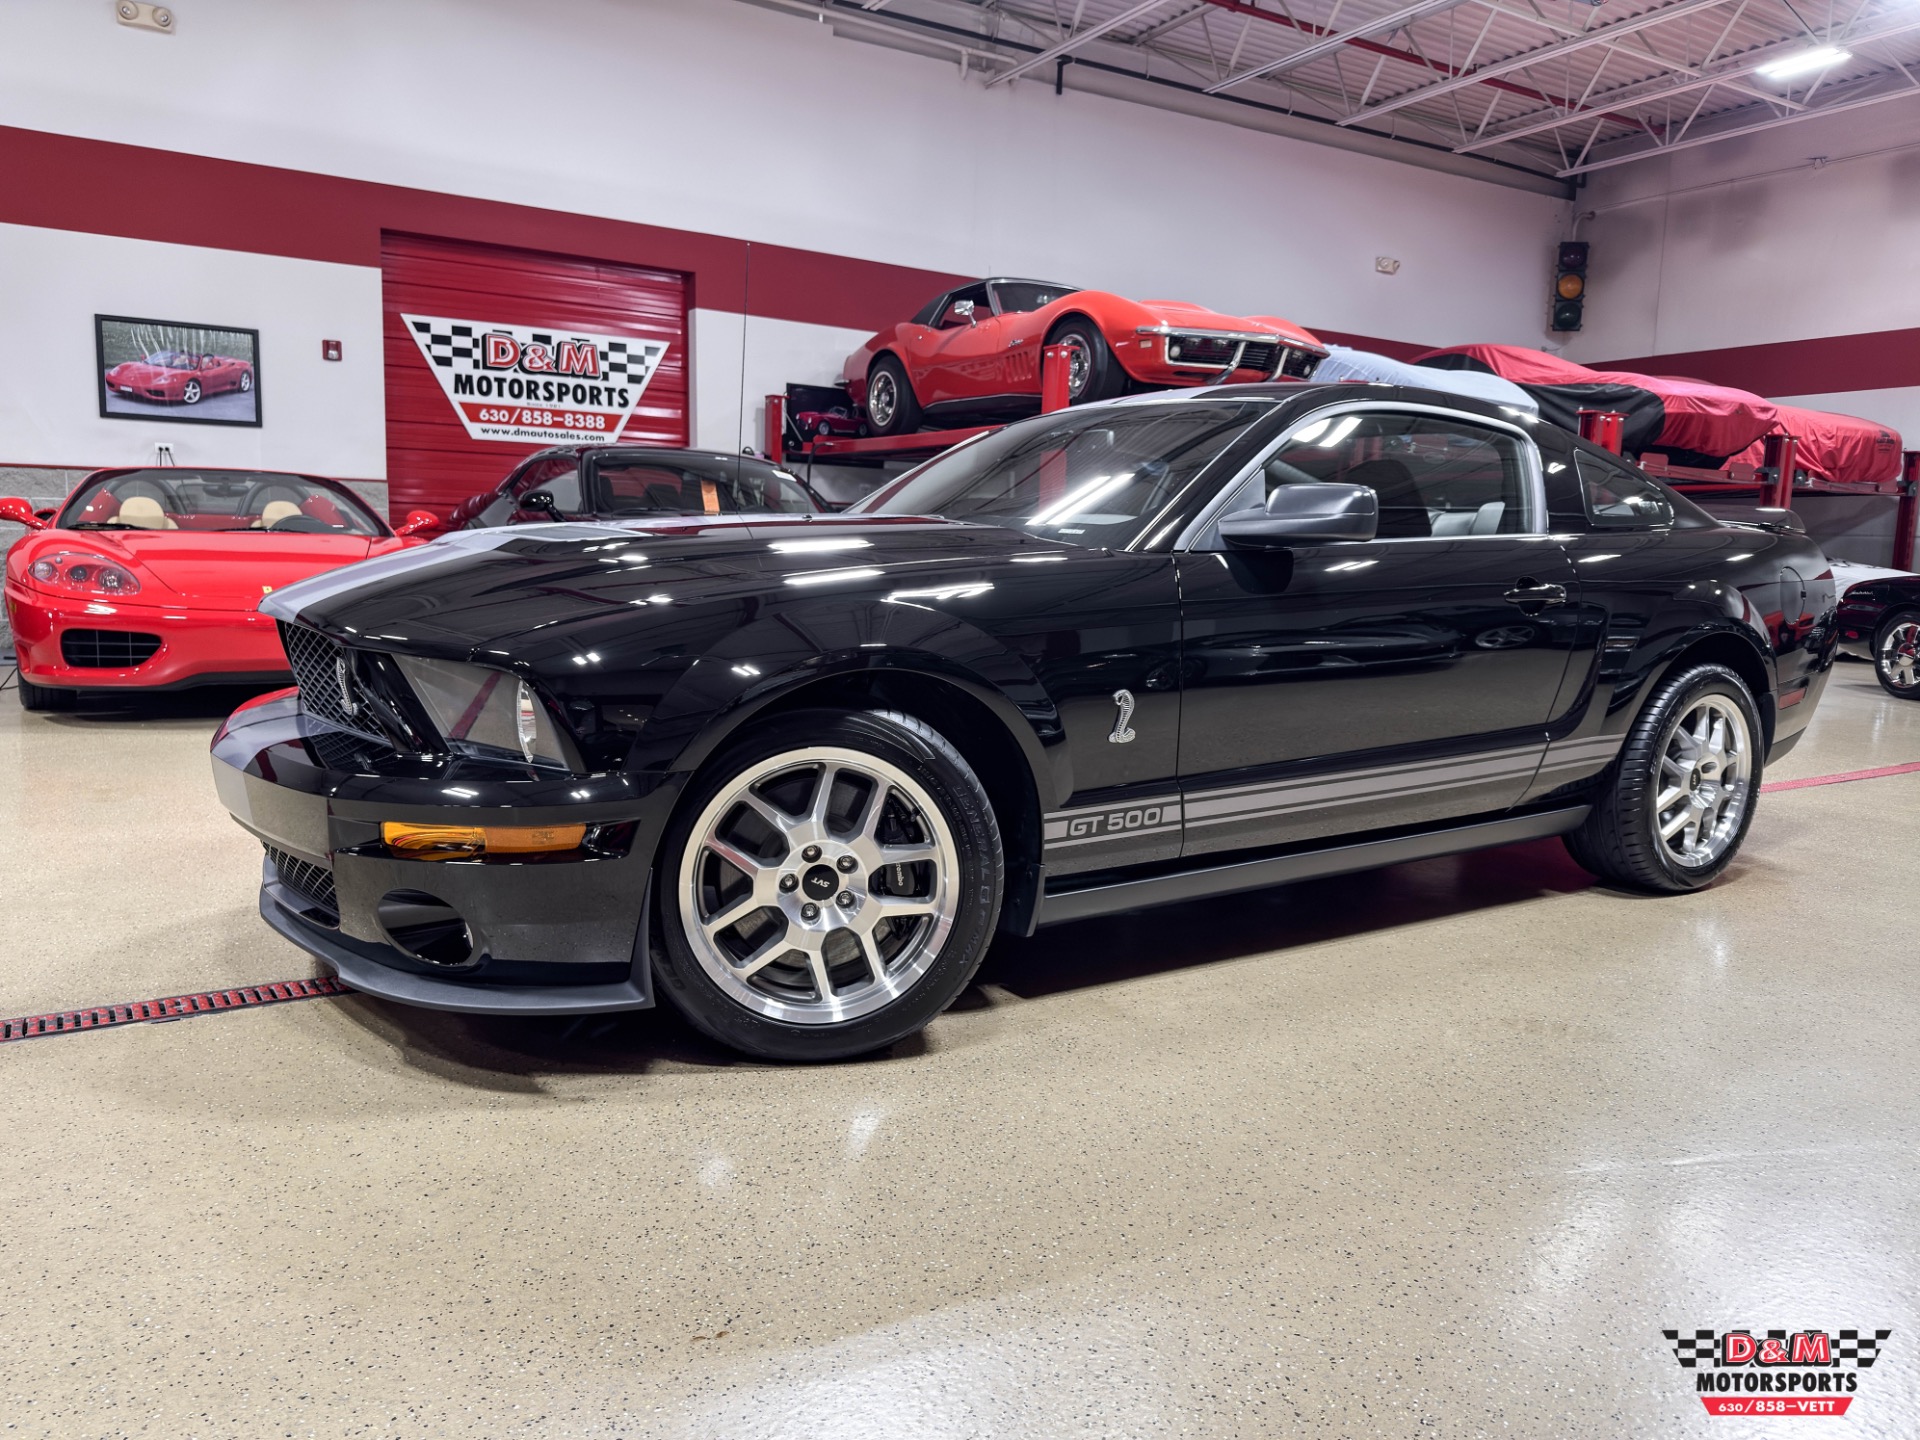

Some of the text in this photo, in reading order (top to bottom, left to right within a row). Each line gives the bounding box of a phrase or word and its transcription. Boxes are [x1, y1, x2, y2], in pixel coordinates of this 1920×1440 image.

[481, 332, 602, 380] D&M
[454, 373, 630, 408] MOTORSPORTS
[480, 426, 605, 442] www.dmautosales.com
[1069, 807, 1161, 836] GT 500
[810, 876, 830, 888] SVT
